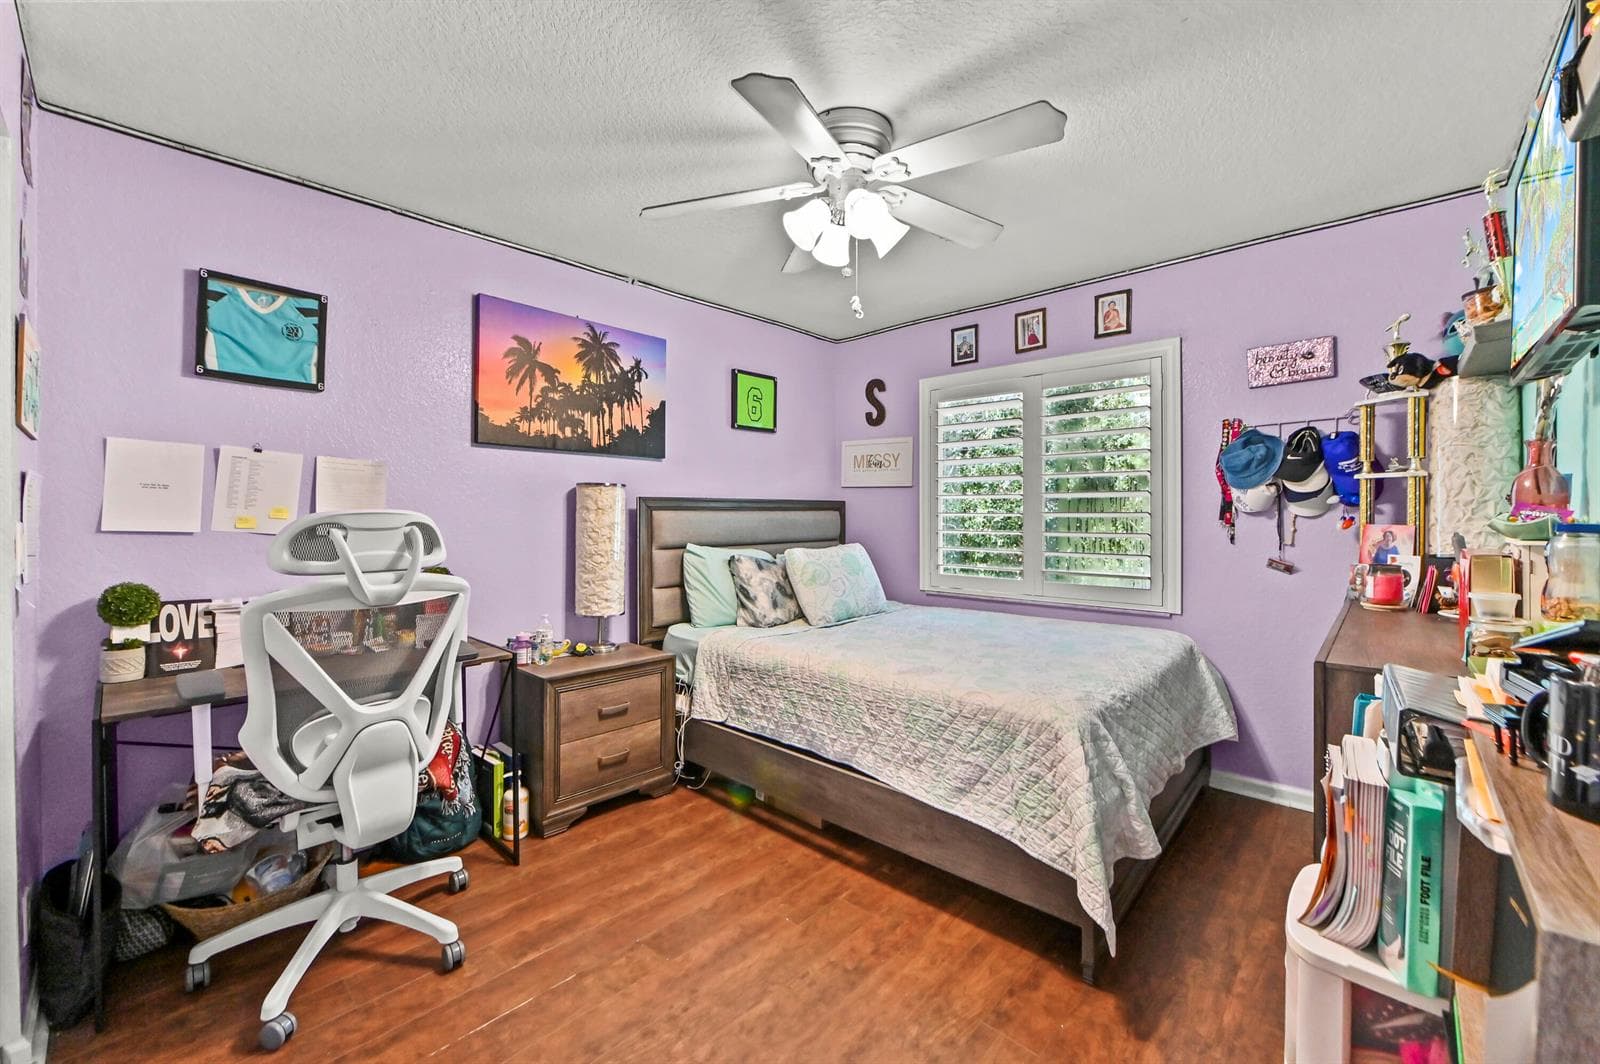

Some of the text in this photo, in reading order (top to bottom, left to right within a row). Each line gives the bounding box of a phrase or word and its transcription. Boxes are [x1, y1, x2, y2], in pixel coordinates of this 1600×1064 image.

[1288, 365, 1326, 377] brains
[747, 386, 763, 422] 6
[865, 378, 886, 427] S
[853, 452, 901, 469] MESSY
[1421, 856, 1432, 878] FILE
[1420, 880, 1432, 906] FOOT
